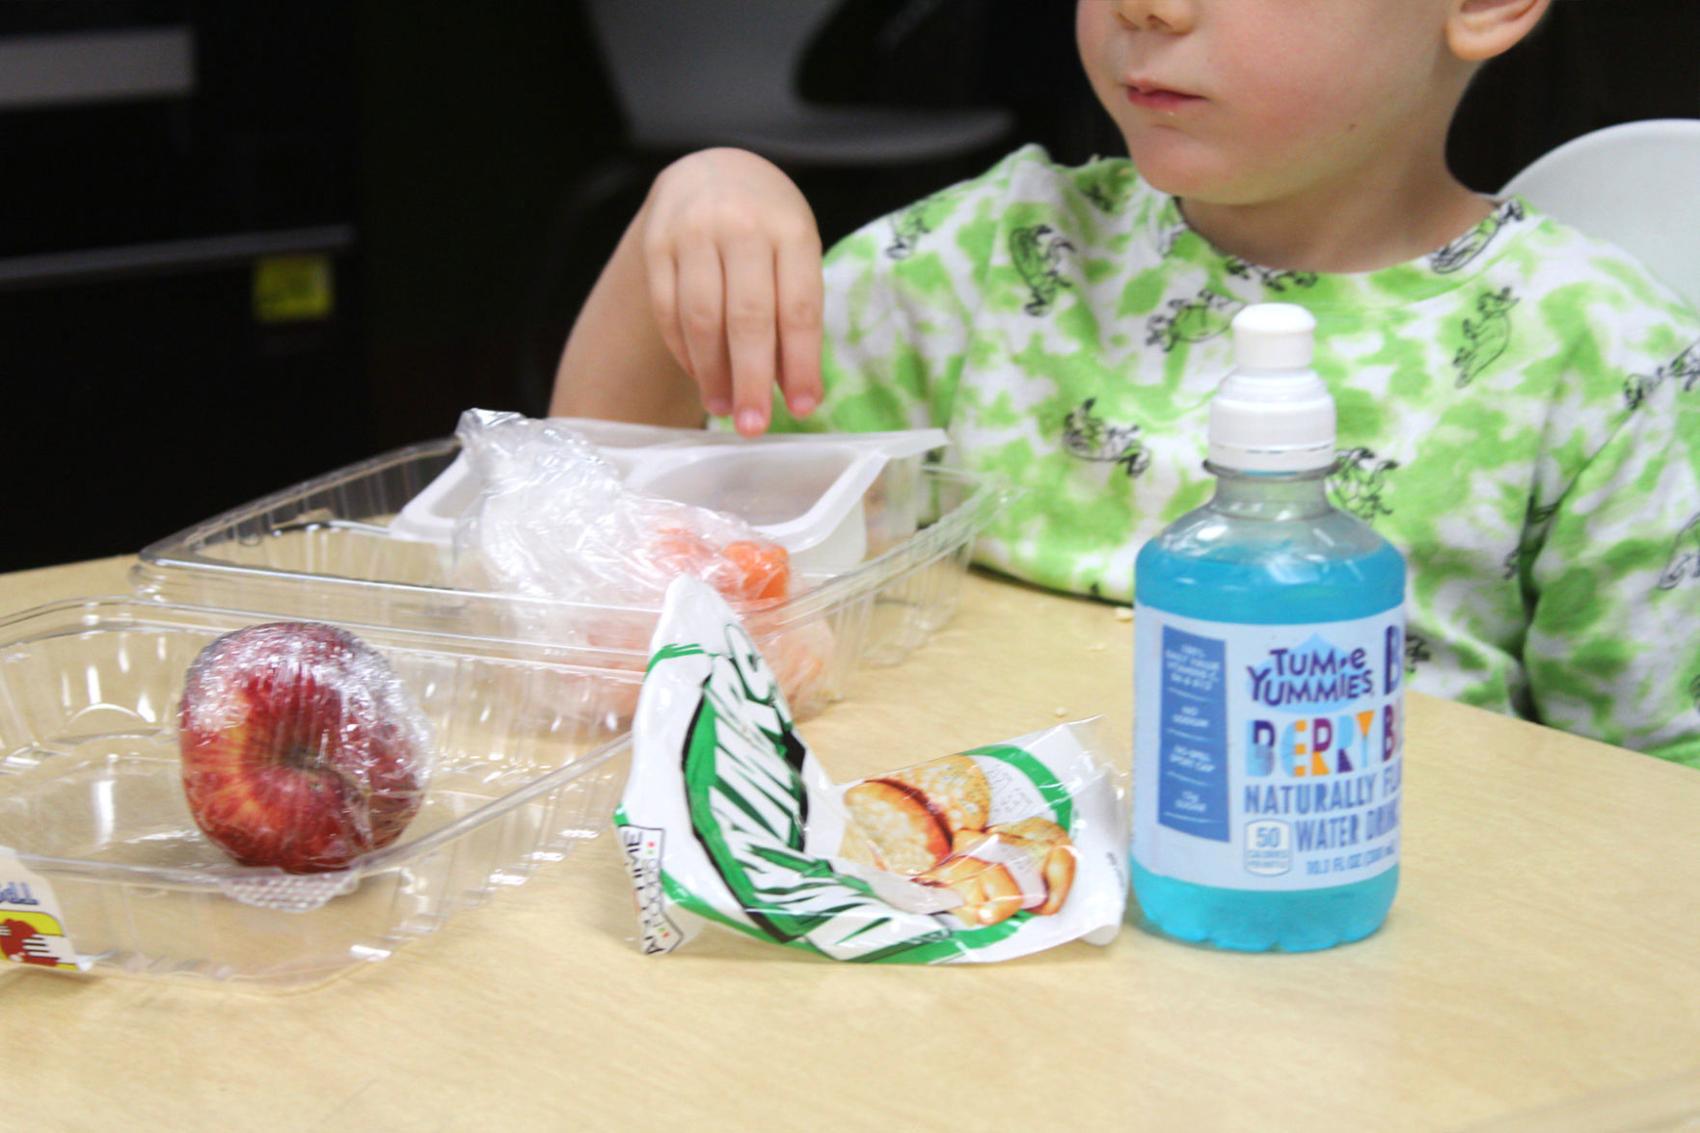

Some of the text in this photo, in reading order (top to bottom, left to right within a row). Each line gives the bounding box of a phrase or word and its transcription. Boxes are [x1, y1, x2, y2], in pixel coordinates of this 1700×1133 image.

[1246, 665, 1373, 707] YUMMIES
[1245, 709, 1376, 778] BERRY
[1244, 773, 1377, 815] NATURALLY
[1256, 827, 1280, 848] 50
[1294, 814, 1358, 853] WATER
